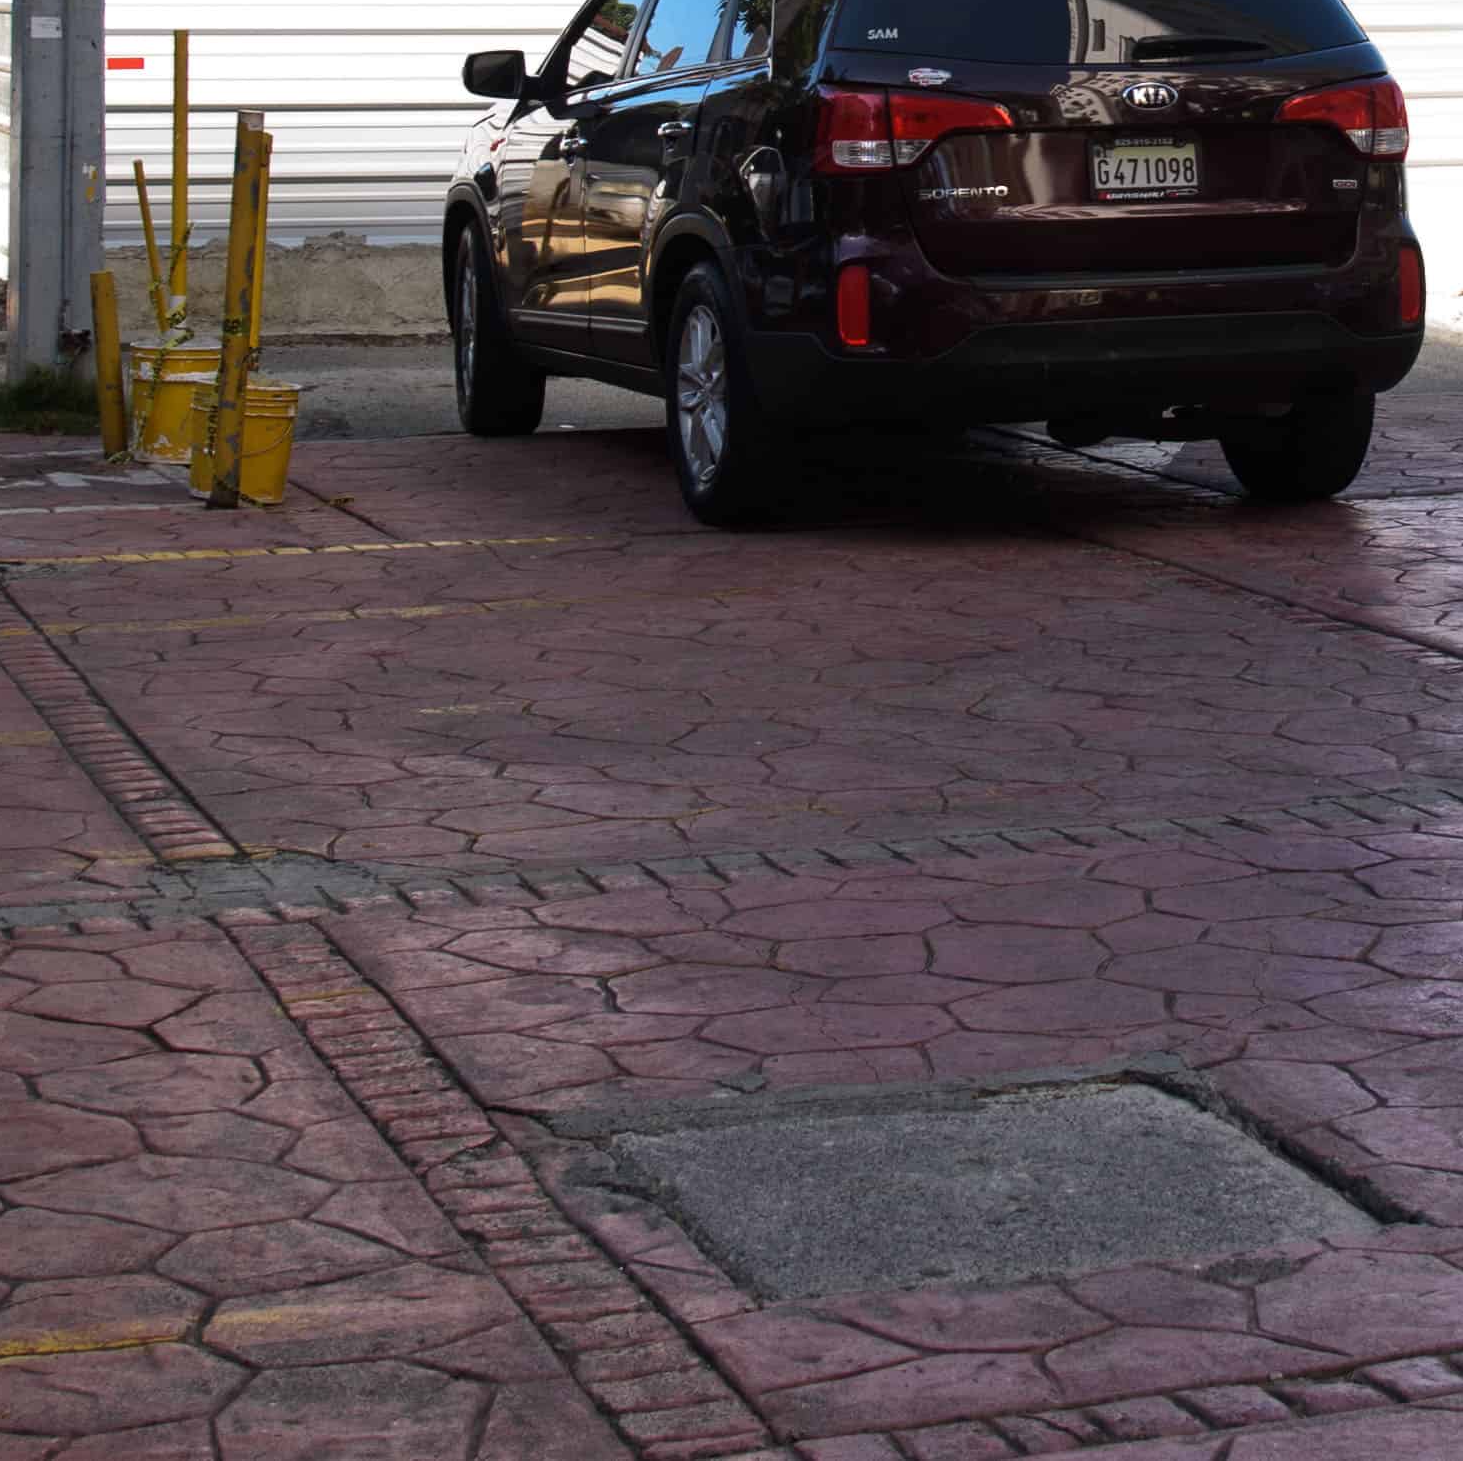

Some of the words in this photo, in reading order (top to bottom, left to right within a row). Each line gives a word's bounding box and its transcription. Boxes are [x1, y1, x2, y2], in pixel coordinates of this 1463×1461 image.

[867, 27, 899, 40] SAM
[1132, 87, 1170, 105] KIA
[1097, 157, 1195, 185] G471098
[919, 185, 1009, 199] SORENTO
